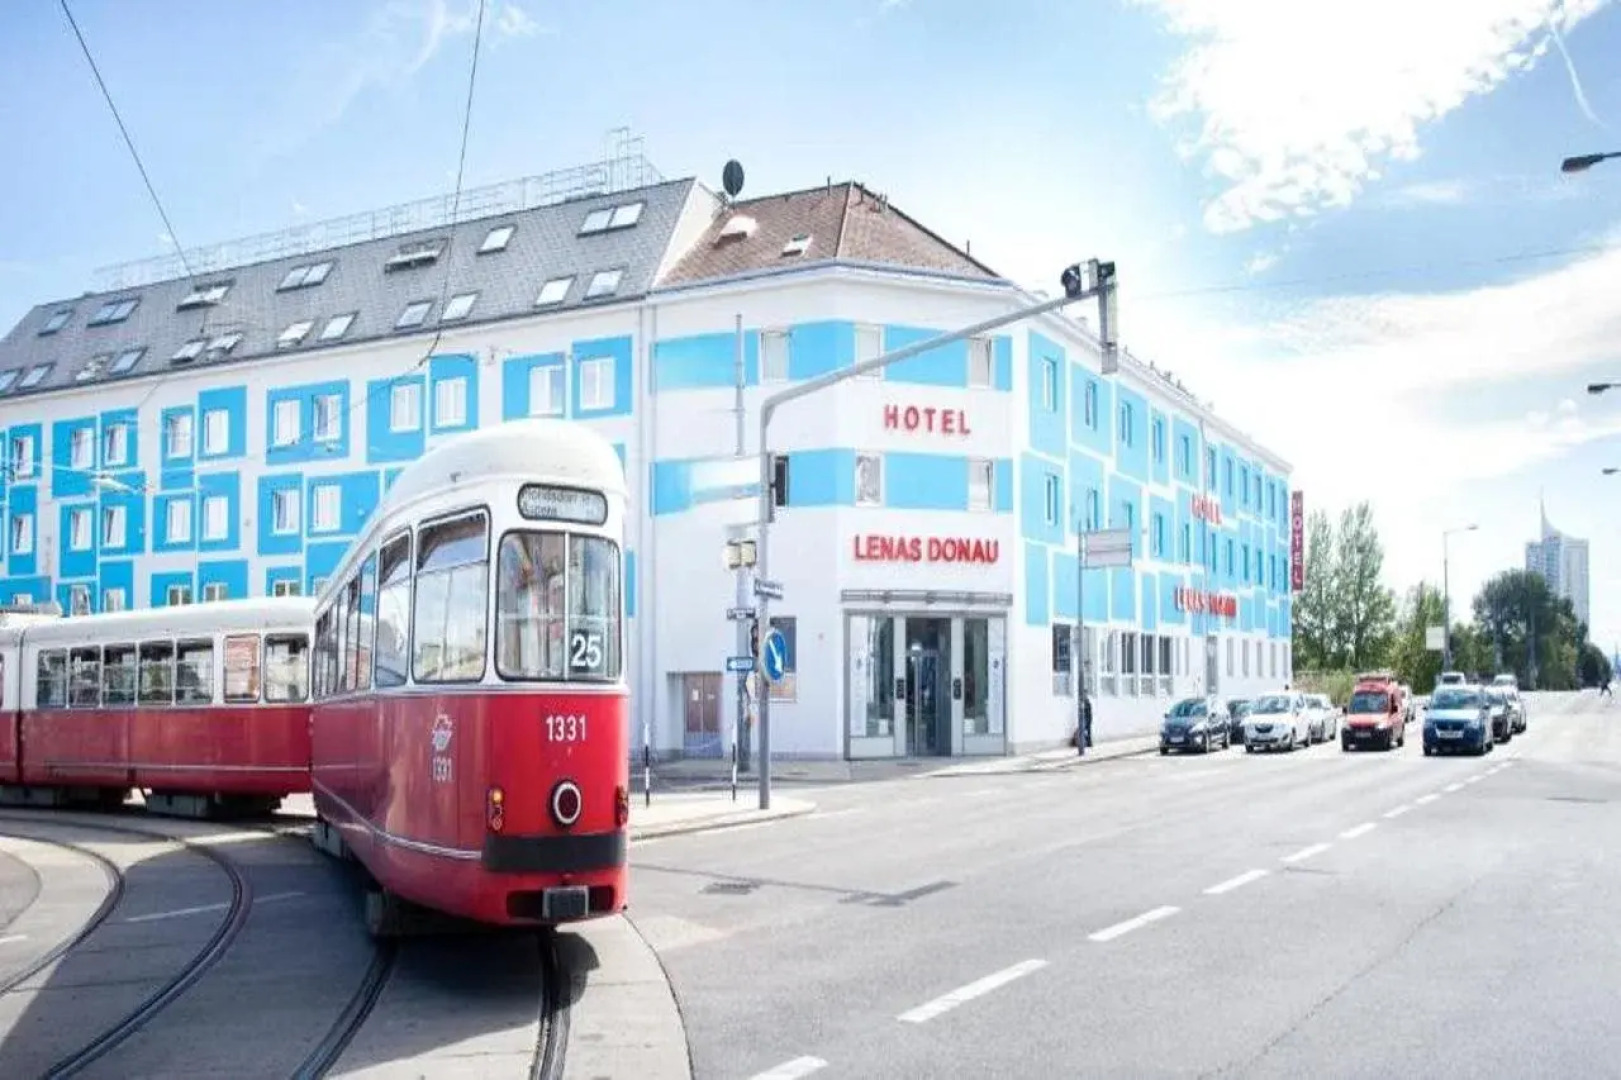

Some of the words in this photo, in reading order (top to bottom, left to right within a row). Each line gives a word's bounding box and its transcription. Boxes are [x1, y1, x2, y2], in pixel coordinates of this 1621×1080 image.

[884, 404, 971, 435] HOTEL
[854, 534, 921, 561] LENAS
[927, 537, 999, 563] DONAU
[1292, 496, 1303, 584] HOTEL
[571, 634, 601, 667] 25
[546, 715, 587, 741] 1331
[432, 757, 452, 782] 1331
